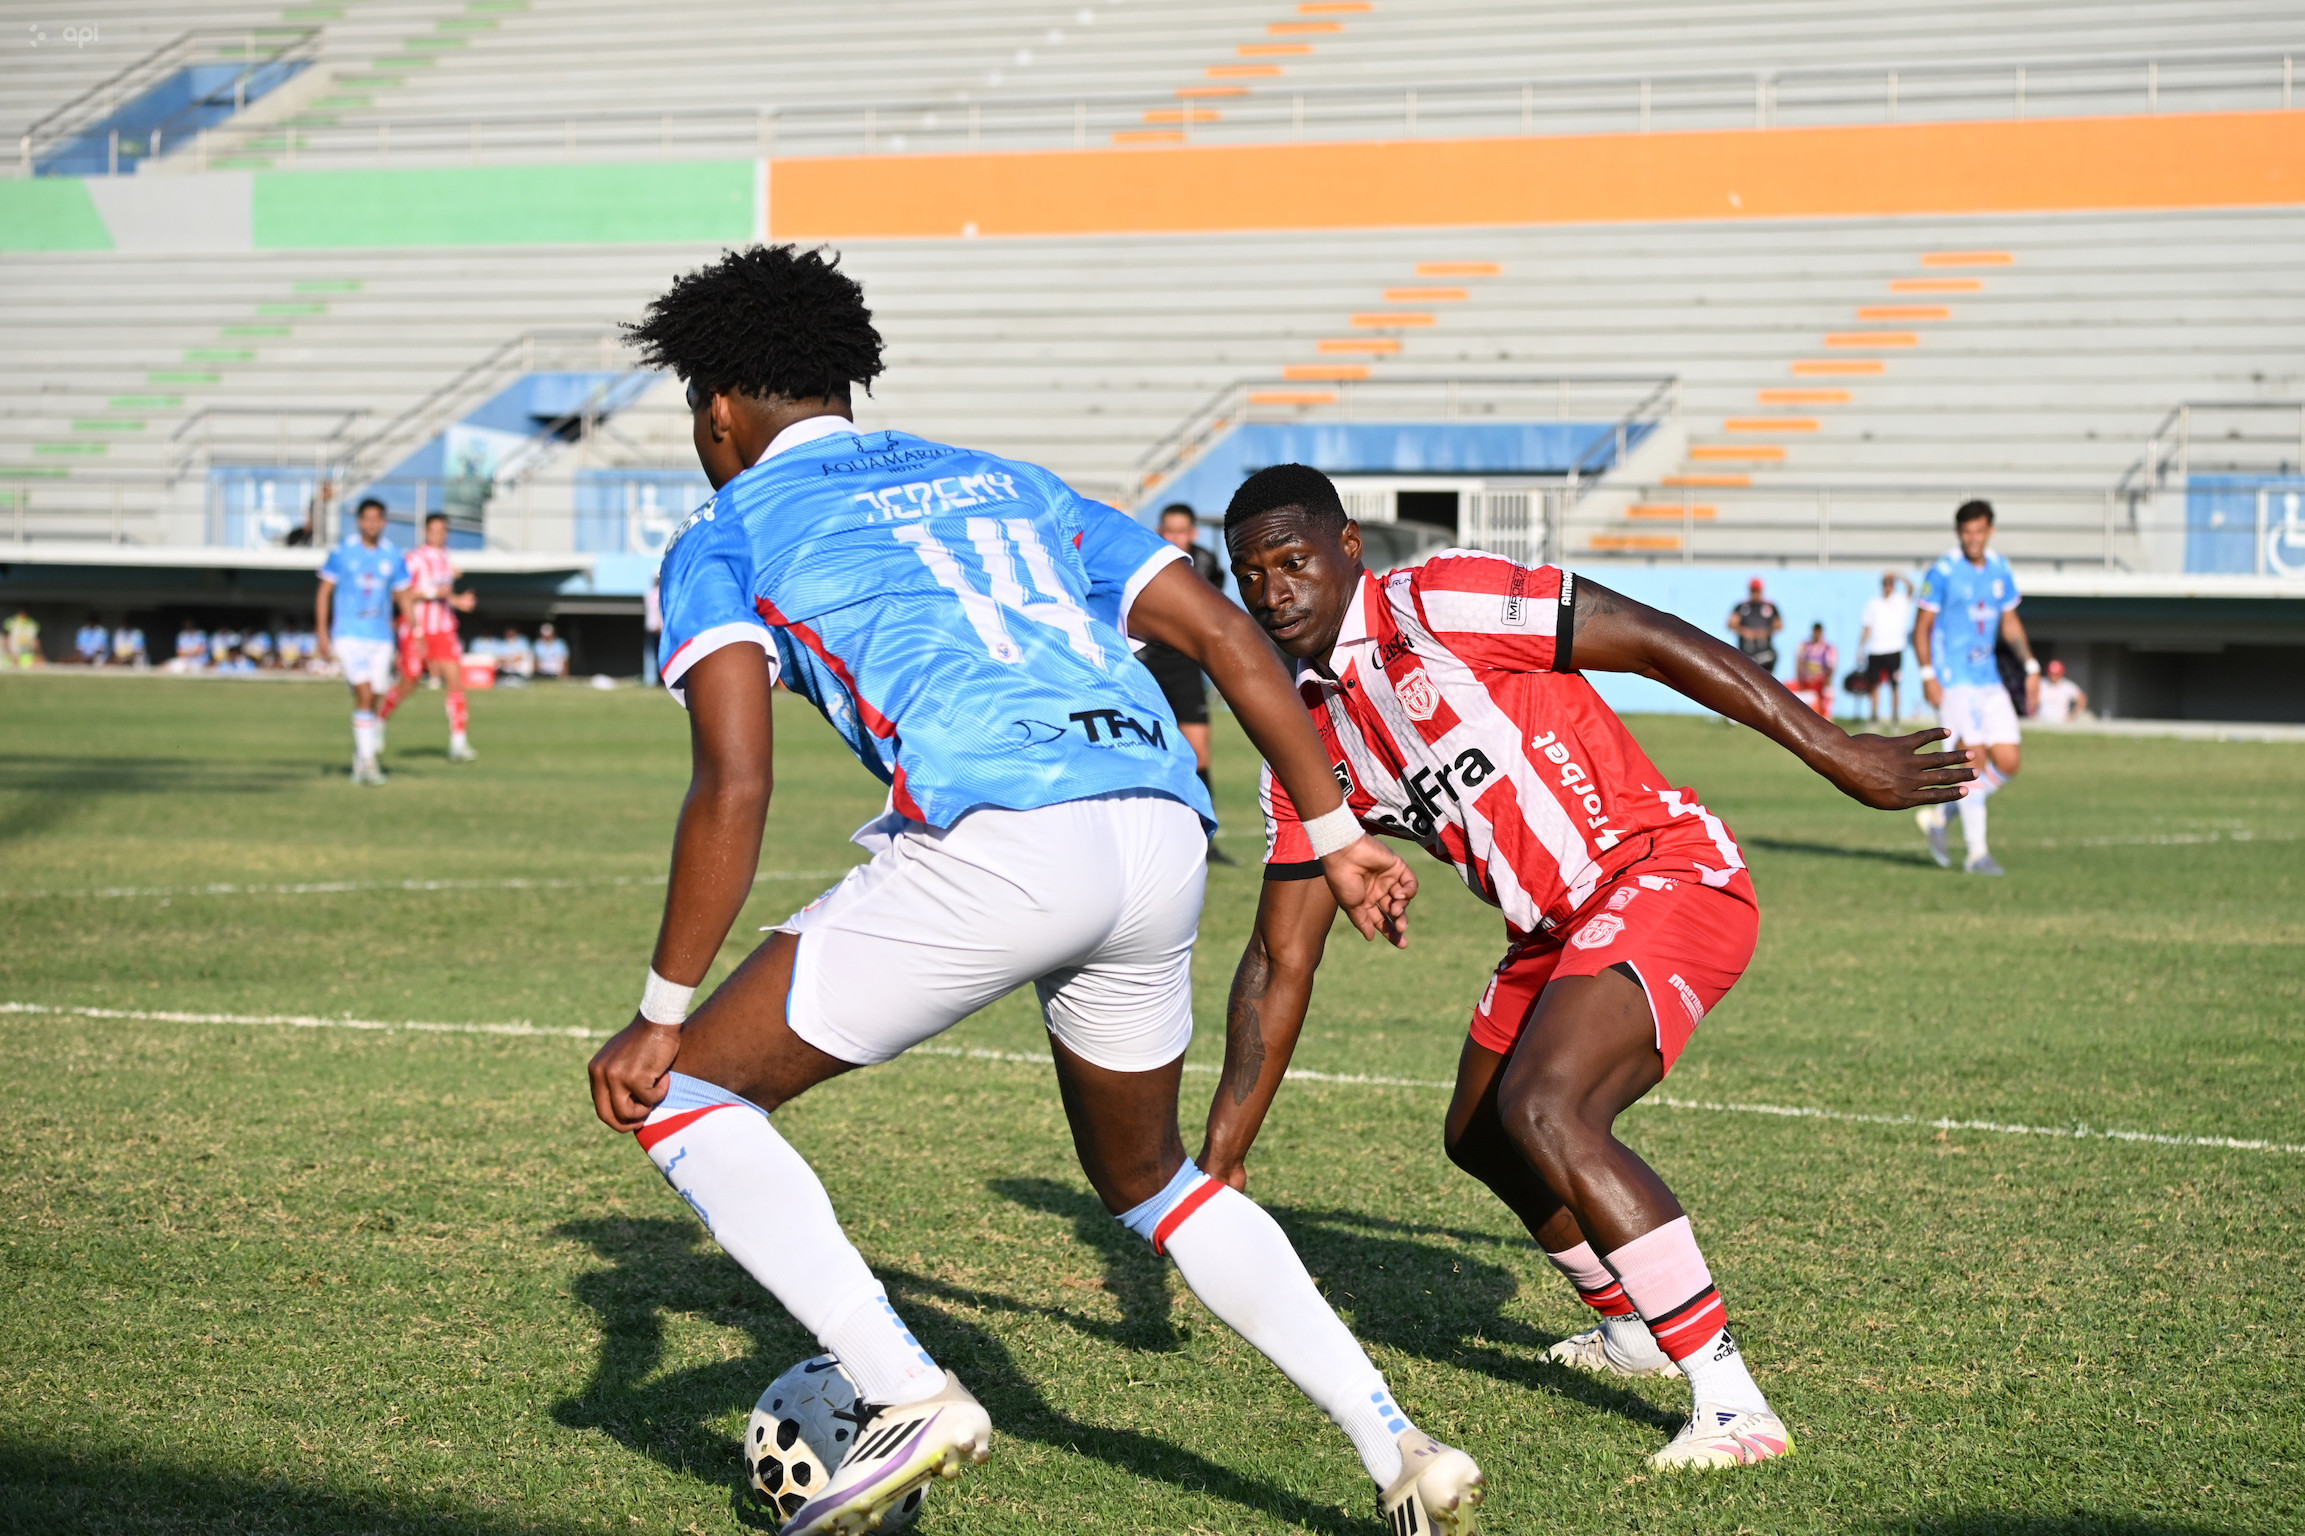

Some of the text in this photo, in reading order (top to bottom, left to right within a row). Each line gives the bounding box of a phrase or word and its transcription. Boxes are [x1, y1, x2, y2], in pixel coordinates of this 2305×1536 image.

[854, 471, 1020, 523] JEREMY
[891, 516, 1109, 673] 14
[1069, 708, 1169, 751] TFM
[1530, 730, 1610, 831] Forbet
